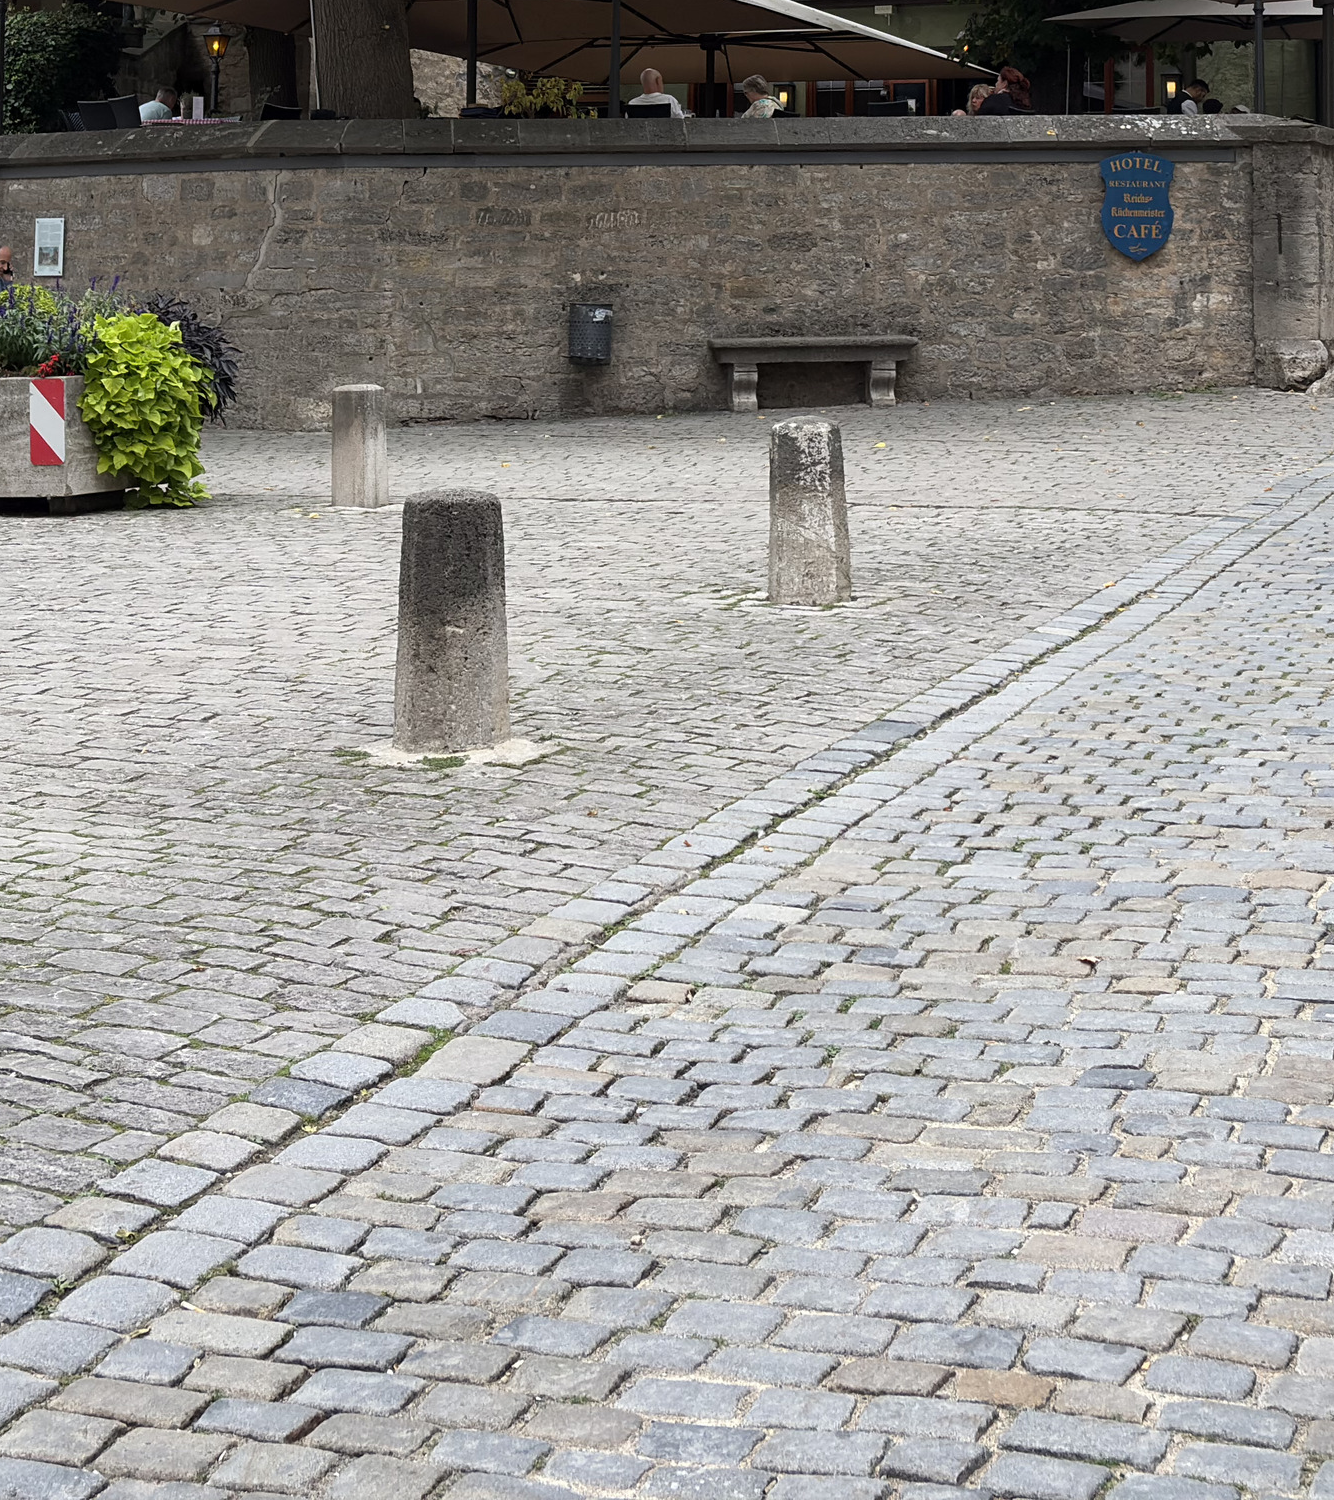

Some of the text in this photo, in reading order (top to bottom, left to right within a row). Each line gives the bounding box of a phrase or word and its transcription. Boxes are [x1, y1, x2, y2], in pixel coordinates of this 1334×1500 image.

[1109, 157, 1162, 173] HOTEL
[1109, 180, 1166, 188] RESTAURANT
[1110, 206, 1165, 217] Küchenmeister
[1113, 220, 1163, 239] CAFÉ
